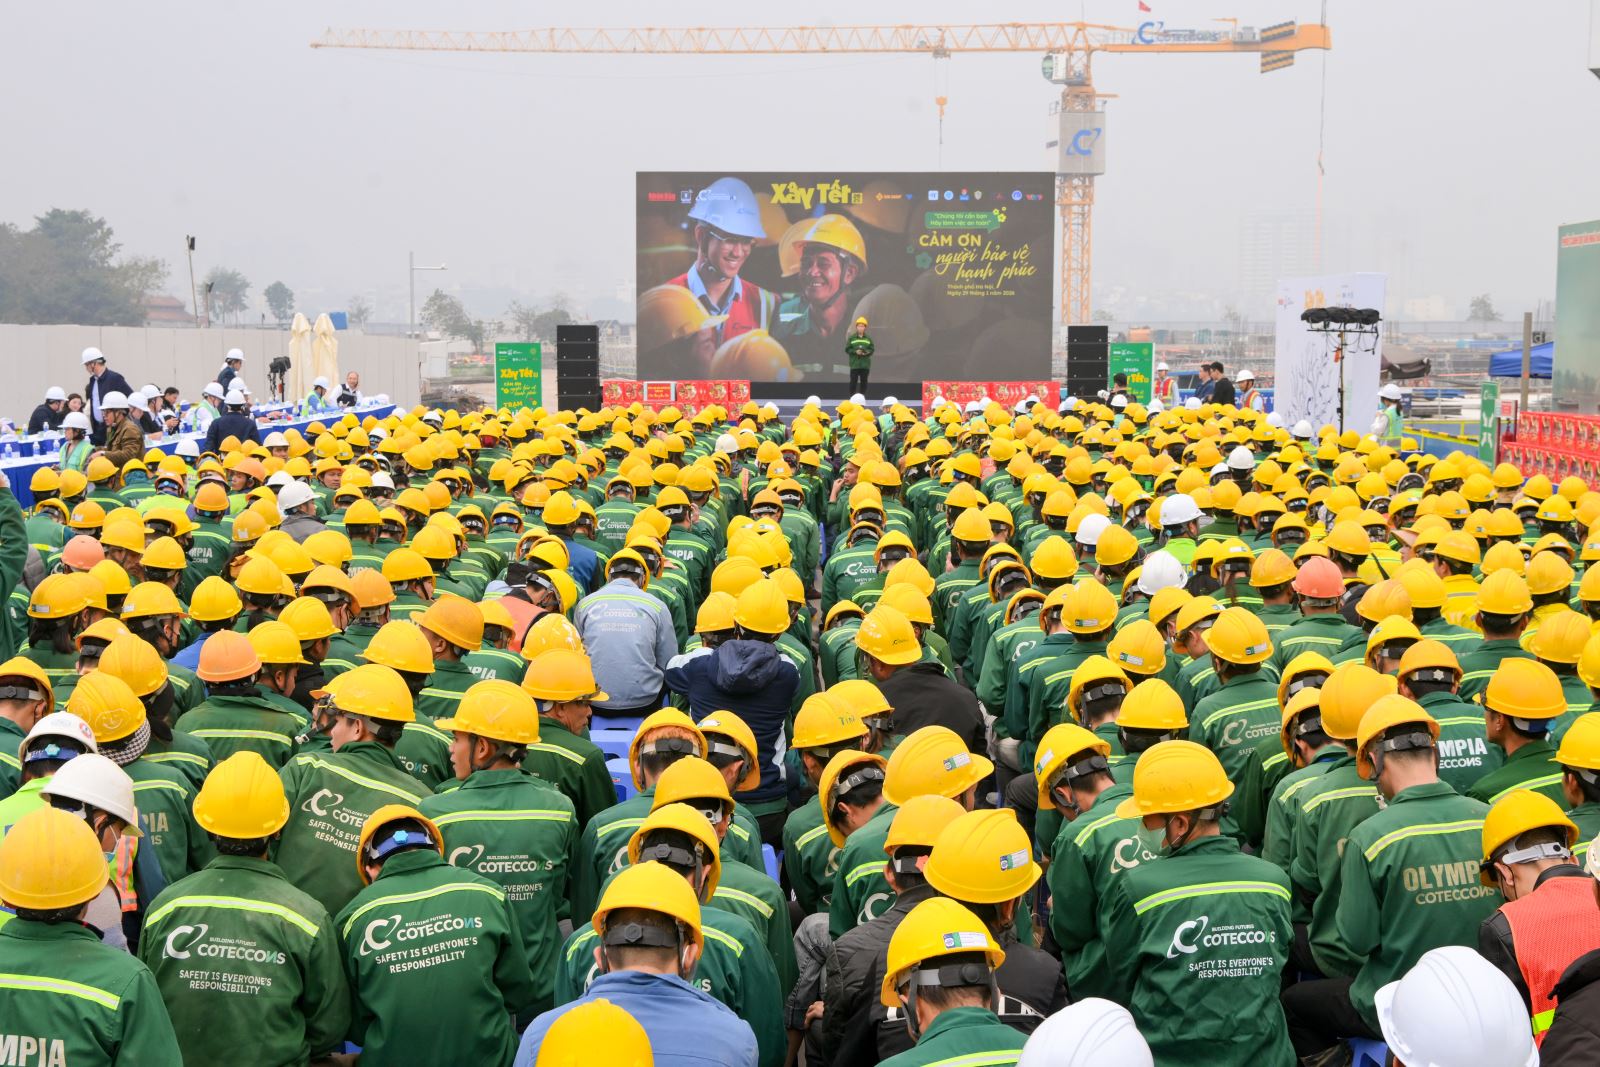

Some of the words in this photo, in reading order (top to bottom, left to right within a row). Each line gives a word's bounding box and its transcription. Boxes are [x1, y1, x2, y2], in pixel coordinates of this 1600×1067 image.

[770, 181, 814, 210] Xây
[816, 179, 852, 204] Tết
[919, 230, 952, 247] CẢM
[957, 233, 982, 247] ƠN
[935, 247, 978, 275] người
[981, 240, 1010, 261] bảo
[1012, 243, 1031, 263] vệ
[955, 261, 995, 282] hạnh
[996, 261, 1037, 289] phúc
[189, 548, 212, 558] MPIA
[1245, 726, 1282, 738] COTECC
[1438, 737, 1488, 758] MPIA
[1438, 757, 1482, 769] ECCONS
[308, 819, 336, 833] SAFETY
[336, 827, 344, 838] IS
[315, 831, 360, 853] RESPONSIB
[478, 860, 553, 873] COTECCONS
[1403, 860, 1483, 892] OLYMP
[396, 916, 483, 942] COTECCONS
[406, 918, 430, 927] BUILDING
[430, 913, 452, 922] FUTURES
[1203, 930, 1276, 948] COTECCONS
[197, 943, 286, 965] COTECCONS
[375, 950, 408, 965] SAFETY
[410, 948, 421, 958] IS
[422, 936, 478, 956] EVERYONE'S
[389, 950, 466, 974] RESPONSIBILITY
[1188, 960, 1216, 972] SAFETY
[1218, 960, 1228, 968] IS
[1229, 957, 1274, 968] EVERYONE'S
[179, 969, 210, 980] SAFETY
[212, 971, 221, 980] IS
[222, 972, 272, 986] EVERYONE'S
[1198, 967, 1263, 979] RESPONSIBILITY
[189, 980, 261, 995] RESPONSIBILITY
[0, 1034, 67, 1067] MPIA
